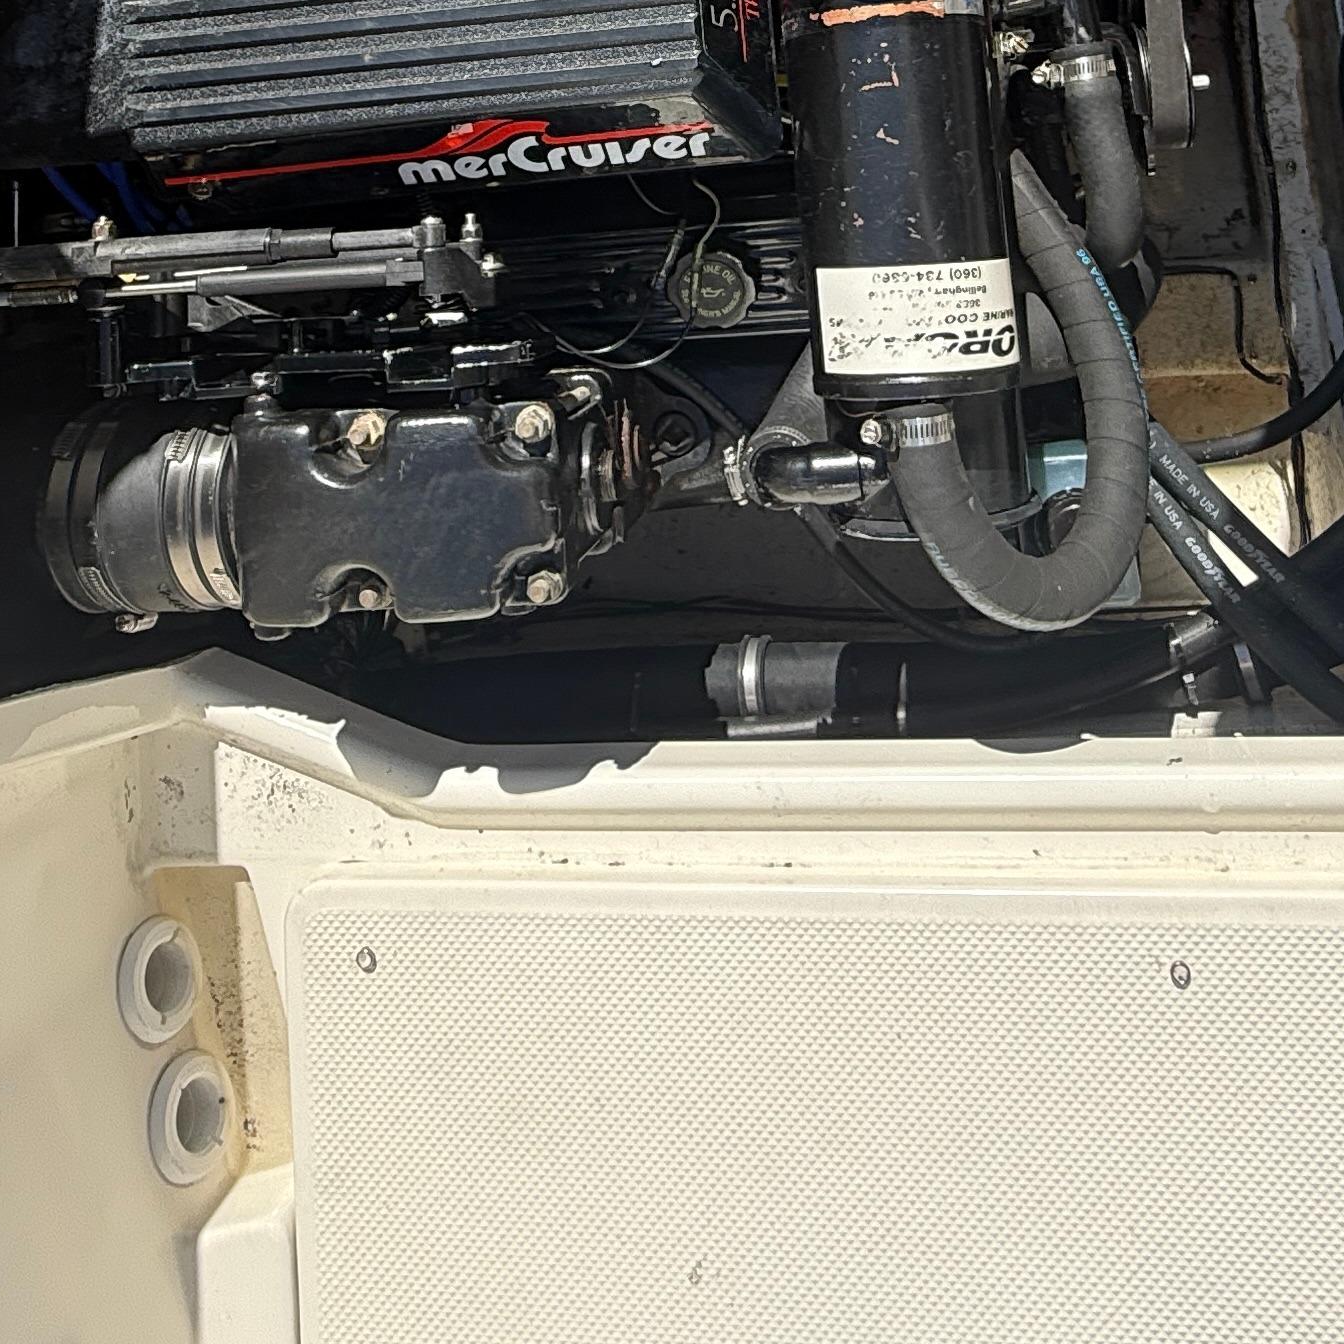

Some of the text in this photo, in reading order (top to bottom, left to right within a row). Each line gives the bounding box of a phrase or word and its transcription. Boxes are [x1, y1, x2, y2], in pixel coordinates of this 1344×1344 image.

[397, 131, 710, 186] merCruiser
[721, 269, 737, 286] OIL
[949, 265, 982, 280] (360)
[1089, 265, 1111, 298] USA
[1158, 454, 1286, 584] MADE IN USA GOODYEAR
[1154, 490, 1241, 604] IN USA GOODYEAR
